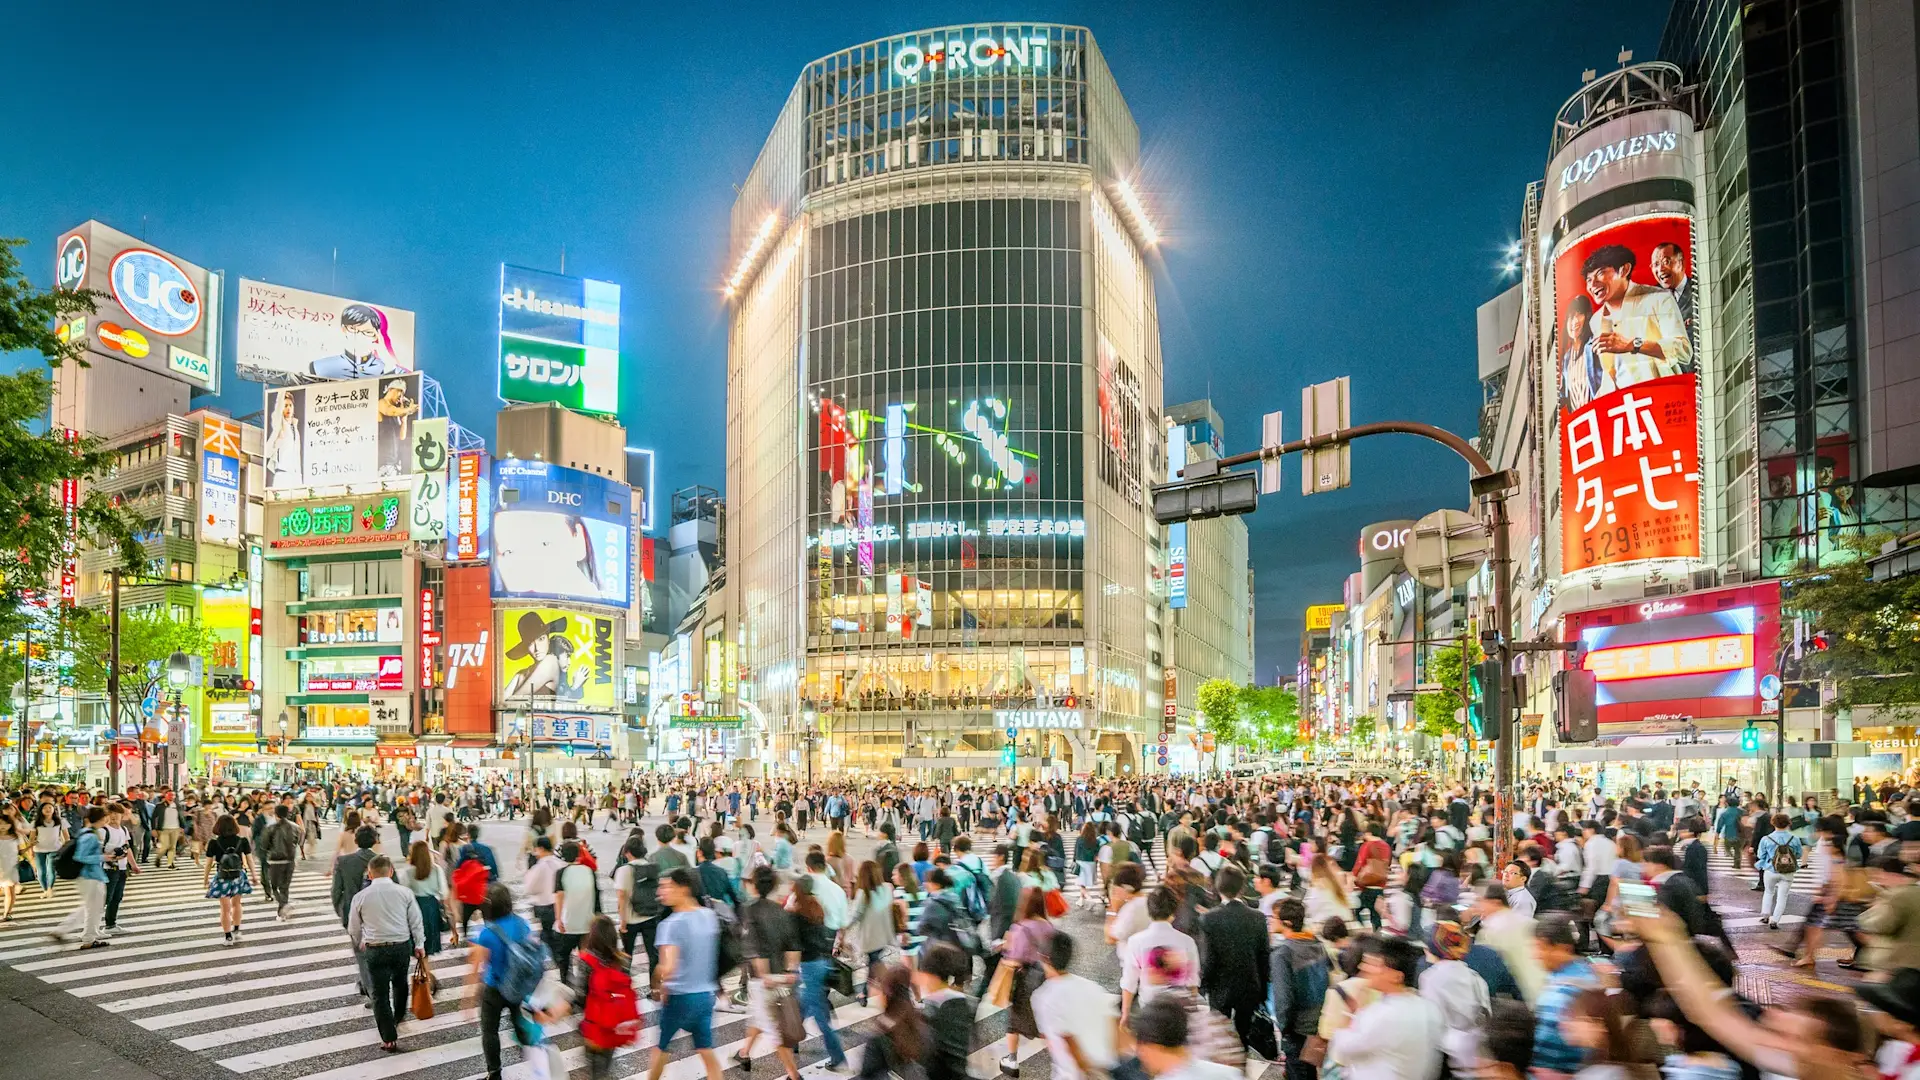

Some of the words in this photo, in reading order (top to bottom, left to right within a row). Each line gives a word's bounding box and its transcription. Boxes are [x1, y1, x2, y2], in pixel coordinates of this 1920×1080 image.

[123, 262, 194, 320] UC
[175, 355, 209, 375] VISA
[315, 405, 328, 413] LIVE
[204, 421, 240, 458] 本
[1567, 393, 1663, 475] 日本
[312, 462, 328, 476] 5.4
[500, 467, 516, 475] DHC
[414, 431, 446, 536] もんじゃ
[1575, 450, 1699, 533] ダービー
[548, 490, 582, 506] DHC
[312, 513, 353, 535] 西村
[1583, 526, 1632, 564] 5.29
[1170, 546, 1185, 600] SEIBU
[308, 629, 376, 644] Euphoria
[574, 615, 593, 660] FX
[595, 618, 612, 684] DMM
[862, 659, 949, 674] STARBUCKS
[959, 659, 1015, 672] COFFEE
[508, 717, 611, 739] 大盛堂書店
[996, 711, 1083, 728] TSUTAYA
